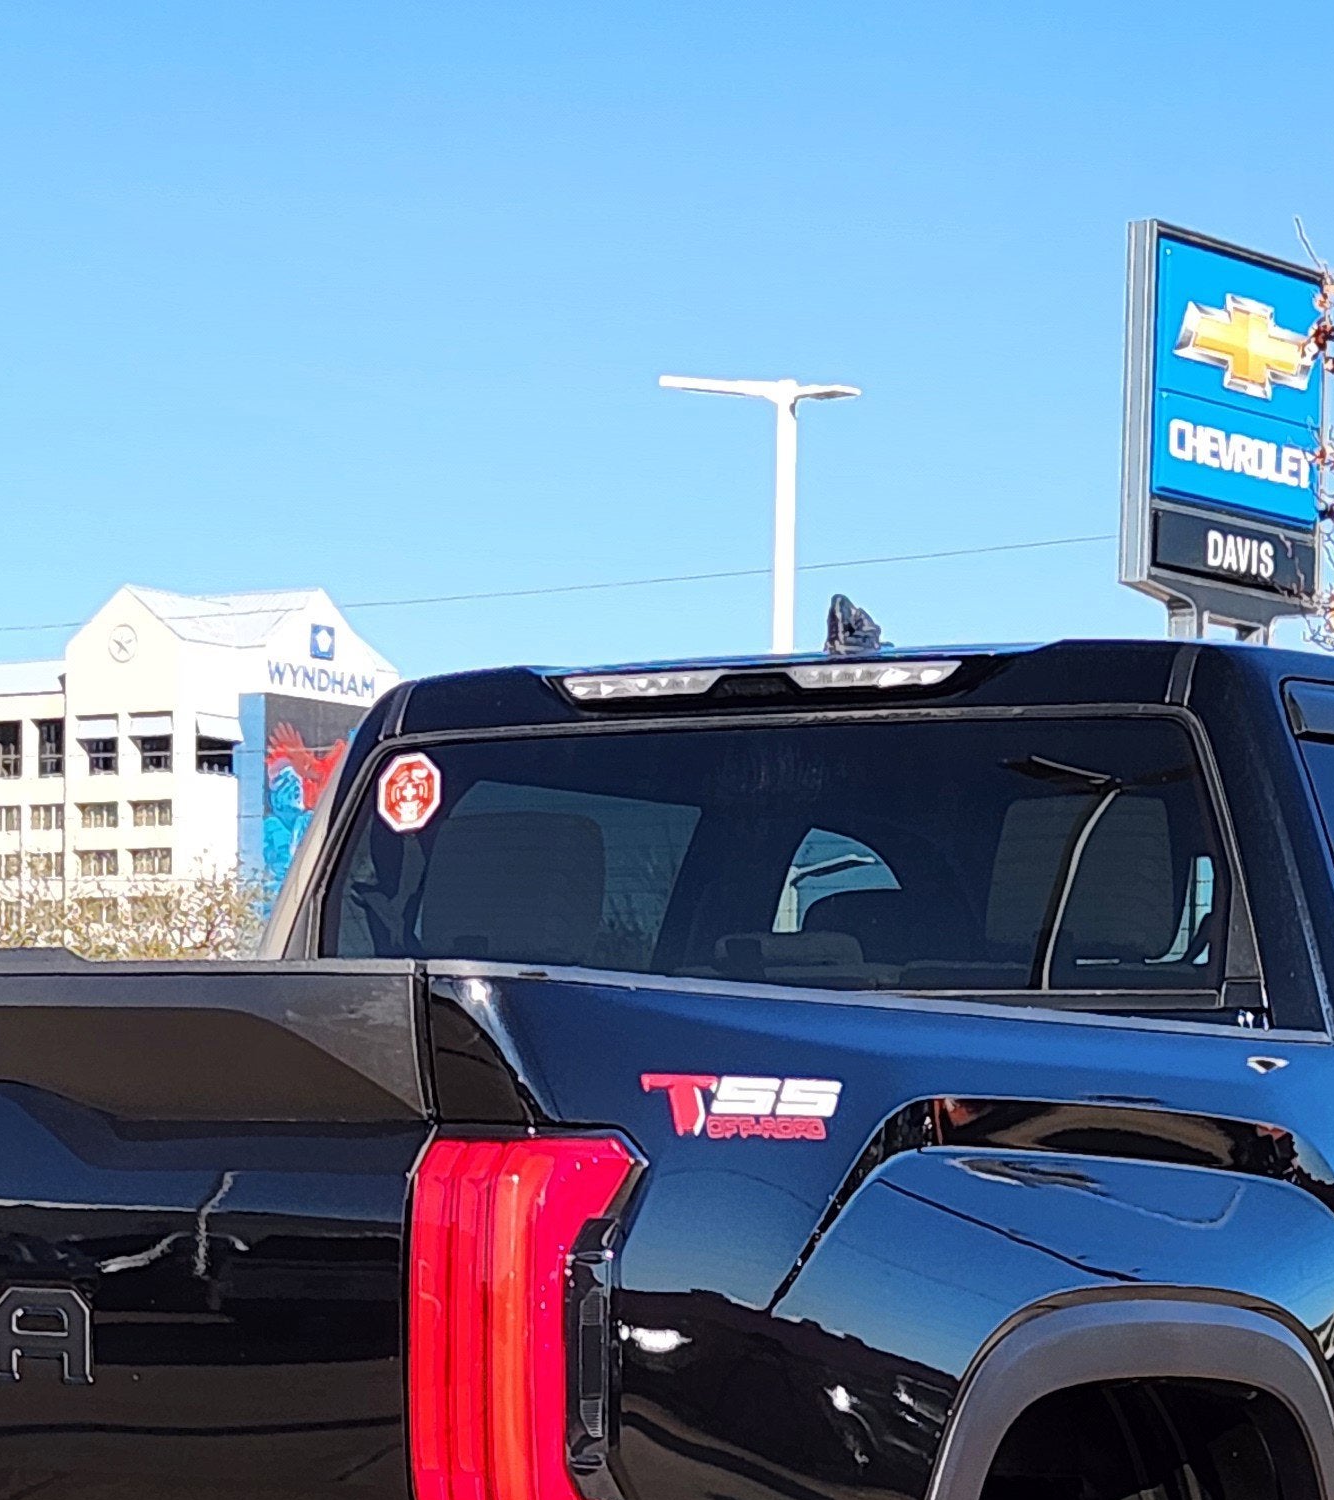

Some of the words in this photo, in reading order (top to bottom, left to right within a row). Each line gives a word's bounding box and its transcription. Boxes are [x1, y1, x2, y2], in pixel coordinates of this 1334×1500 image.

[1169, 418, 1313, 489] CHEVROLET
[1207, 530, 1275, 579] DAVIS
[267, 660, 375, 698] WYNDHAM
[640, 1073, 843, 1136] TSS
